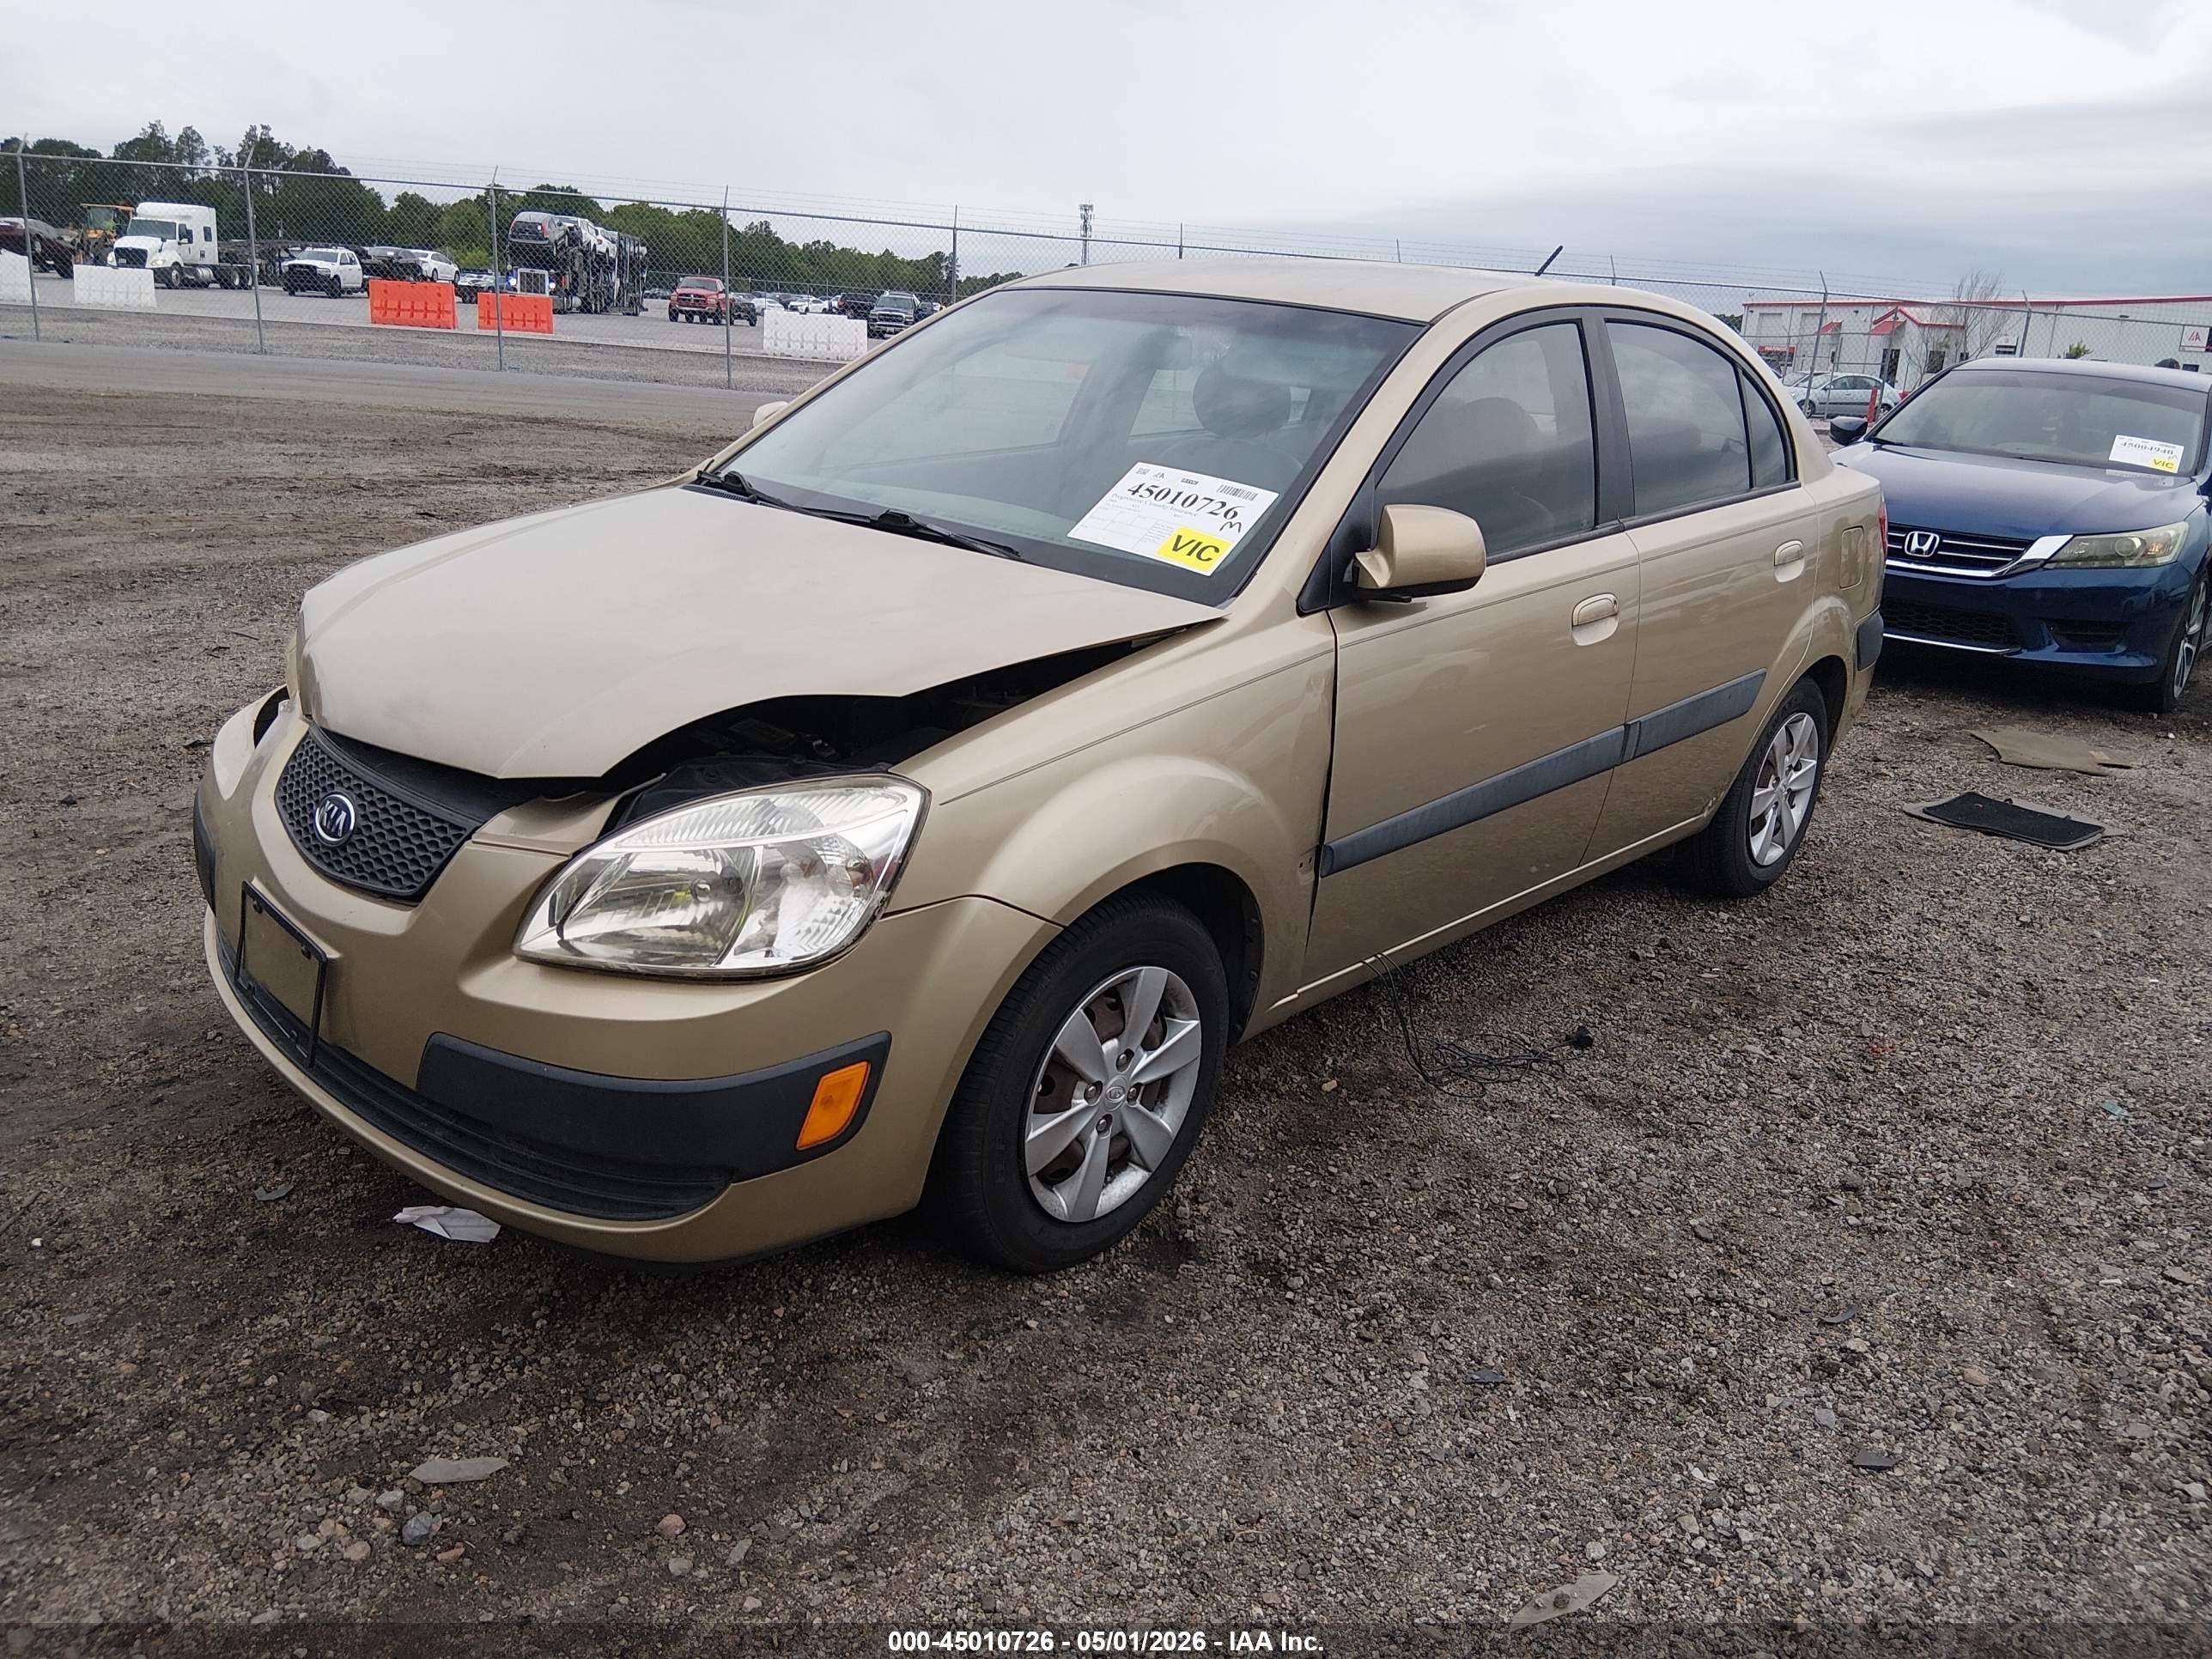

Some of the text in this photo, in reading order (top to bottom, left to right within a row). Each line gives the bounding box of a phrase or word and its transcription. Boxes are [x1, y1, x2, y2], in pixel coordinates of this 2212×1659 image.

[2153, 459, 2174, 469] VIC
[1127, 483, 1244, 520] 45010726
[1172, 534, 1220, 562] VIC
